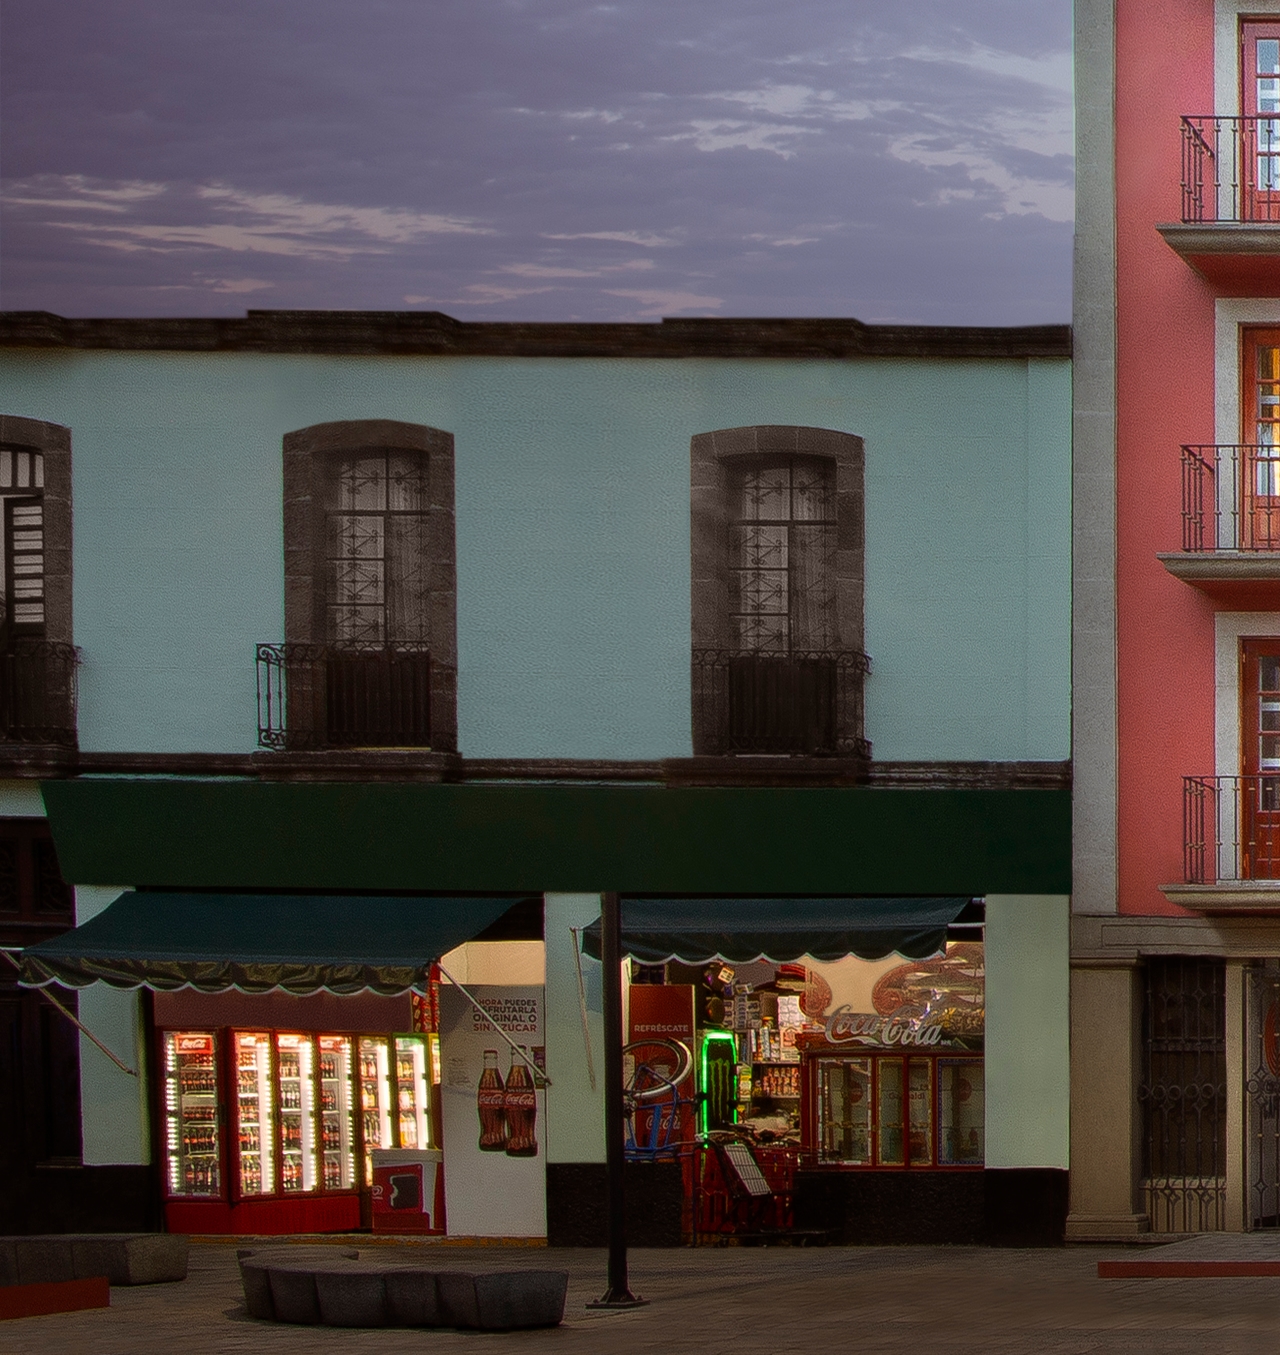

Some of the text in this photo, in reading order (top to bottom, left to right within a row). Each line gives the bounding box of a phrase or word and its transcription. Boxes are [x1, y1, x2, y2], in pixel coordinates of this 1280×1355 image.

[472, 1013, 537, 1023] ORGINAL O
[825, 995, 943, 1046] Coca-Cola
[473, 1023, 490, 1032] SIN
[634, 1023, 689, 1033] REFRÉSCATE
